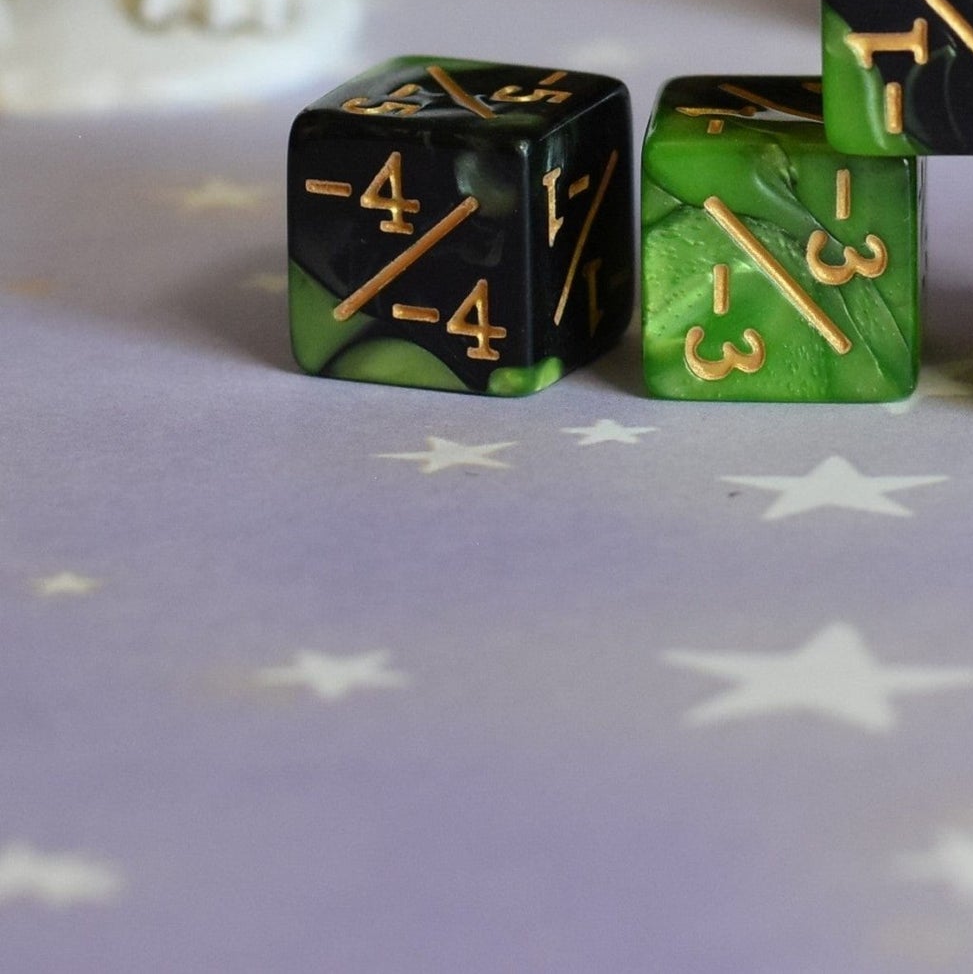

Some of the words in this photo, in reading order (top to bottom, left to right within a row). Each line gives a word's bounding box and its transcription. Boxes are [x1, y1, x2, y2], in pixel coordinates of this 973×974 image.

[843, 17, 929, 135] -1
[305, 151, 421, 235] -4
[392, 278, 508, 361] -4
[805, 169, 888, 286] -3
[684, 263, 766, 381] -3
